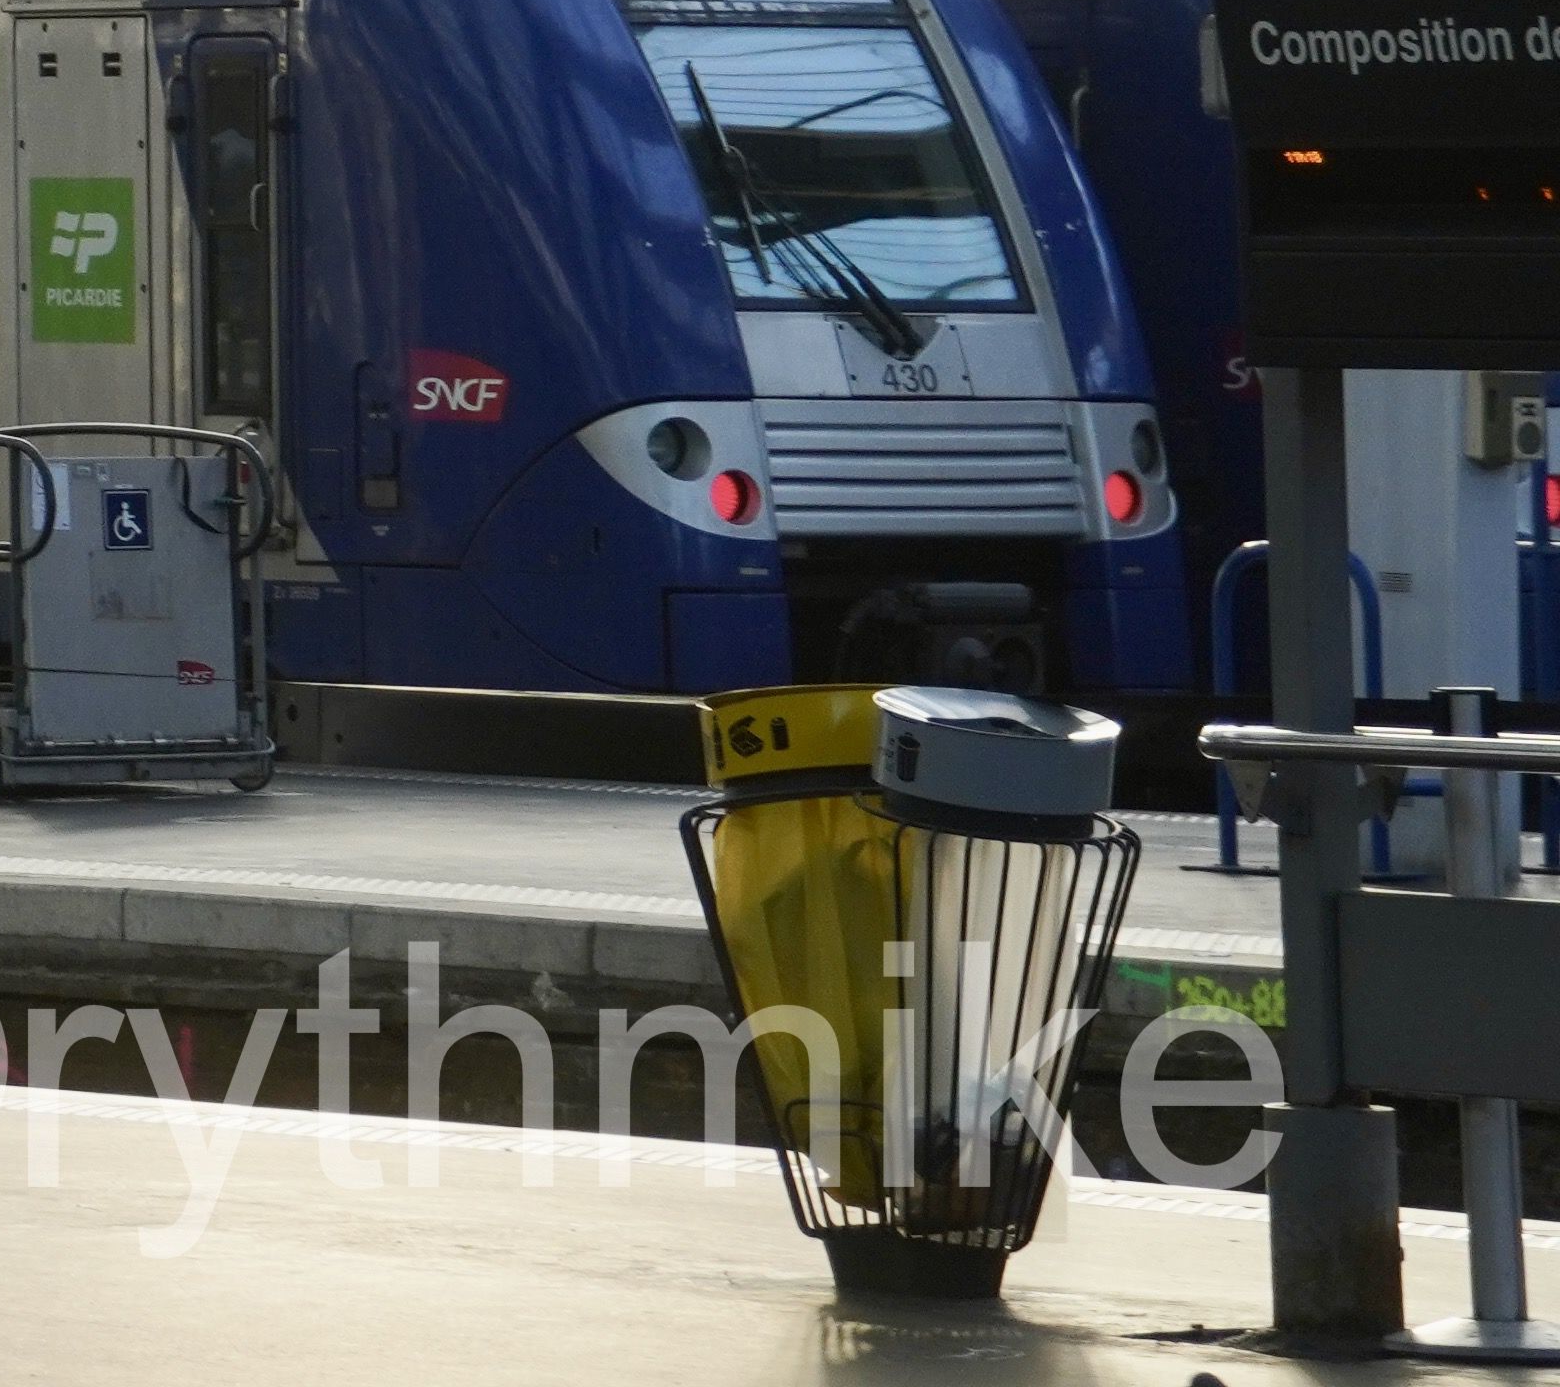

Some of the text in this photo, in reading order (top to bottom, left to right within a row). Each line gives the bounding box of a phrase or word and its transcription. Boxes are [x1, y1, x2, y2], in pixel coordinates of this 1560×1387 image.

[1250, 17, 1514, 75] Composition
[46, 287, 122, 307] PICARDIE
[413, 377, 504, 412] SNCF
[882, 364, 938, 393] 430
